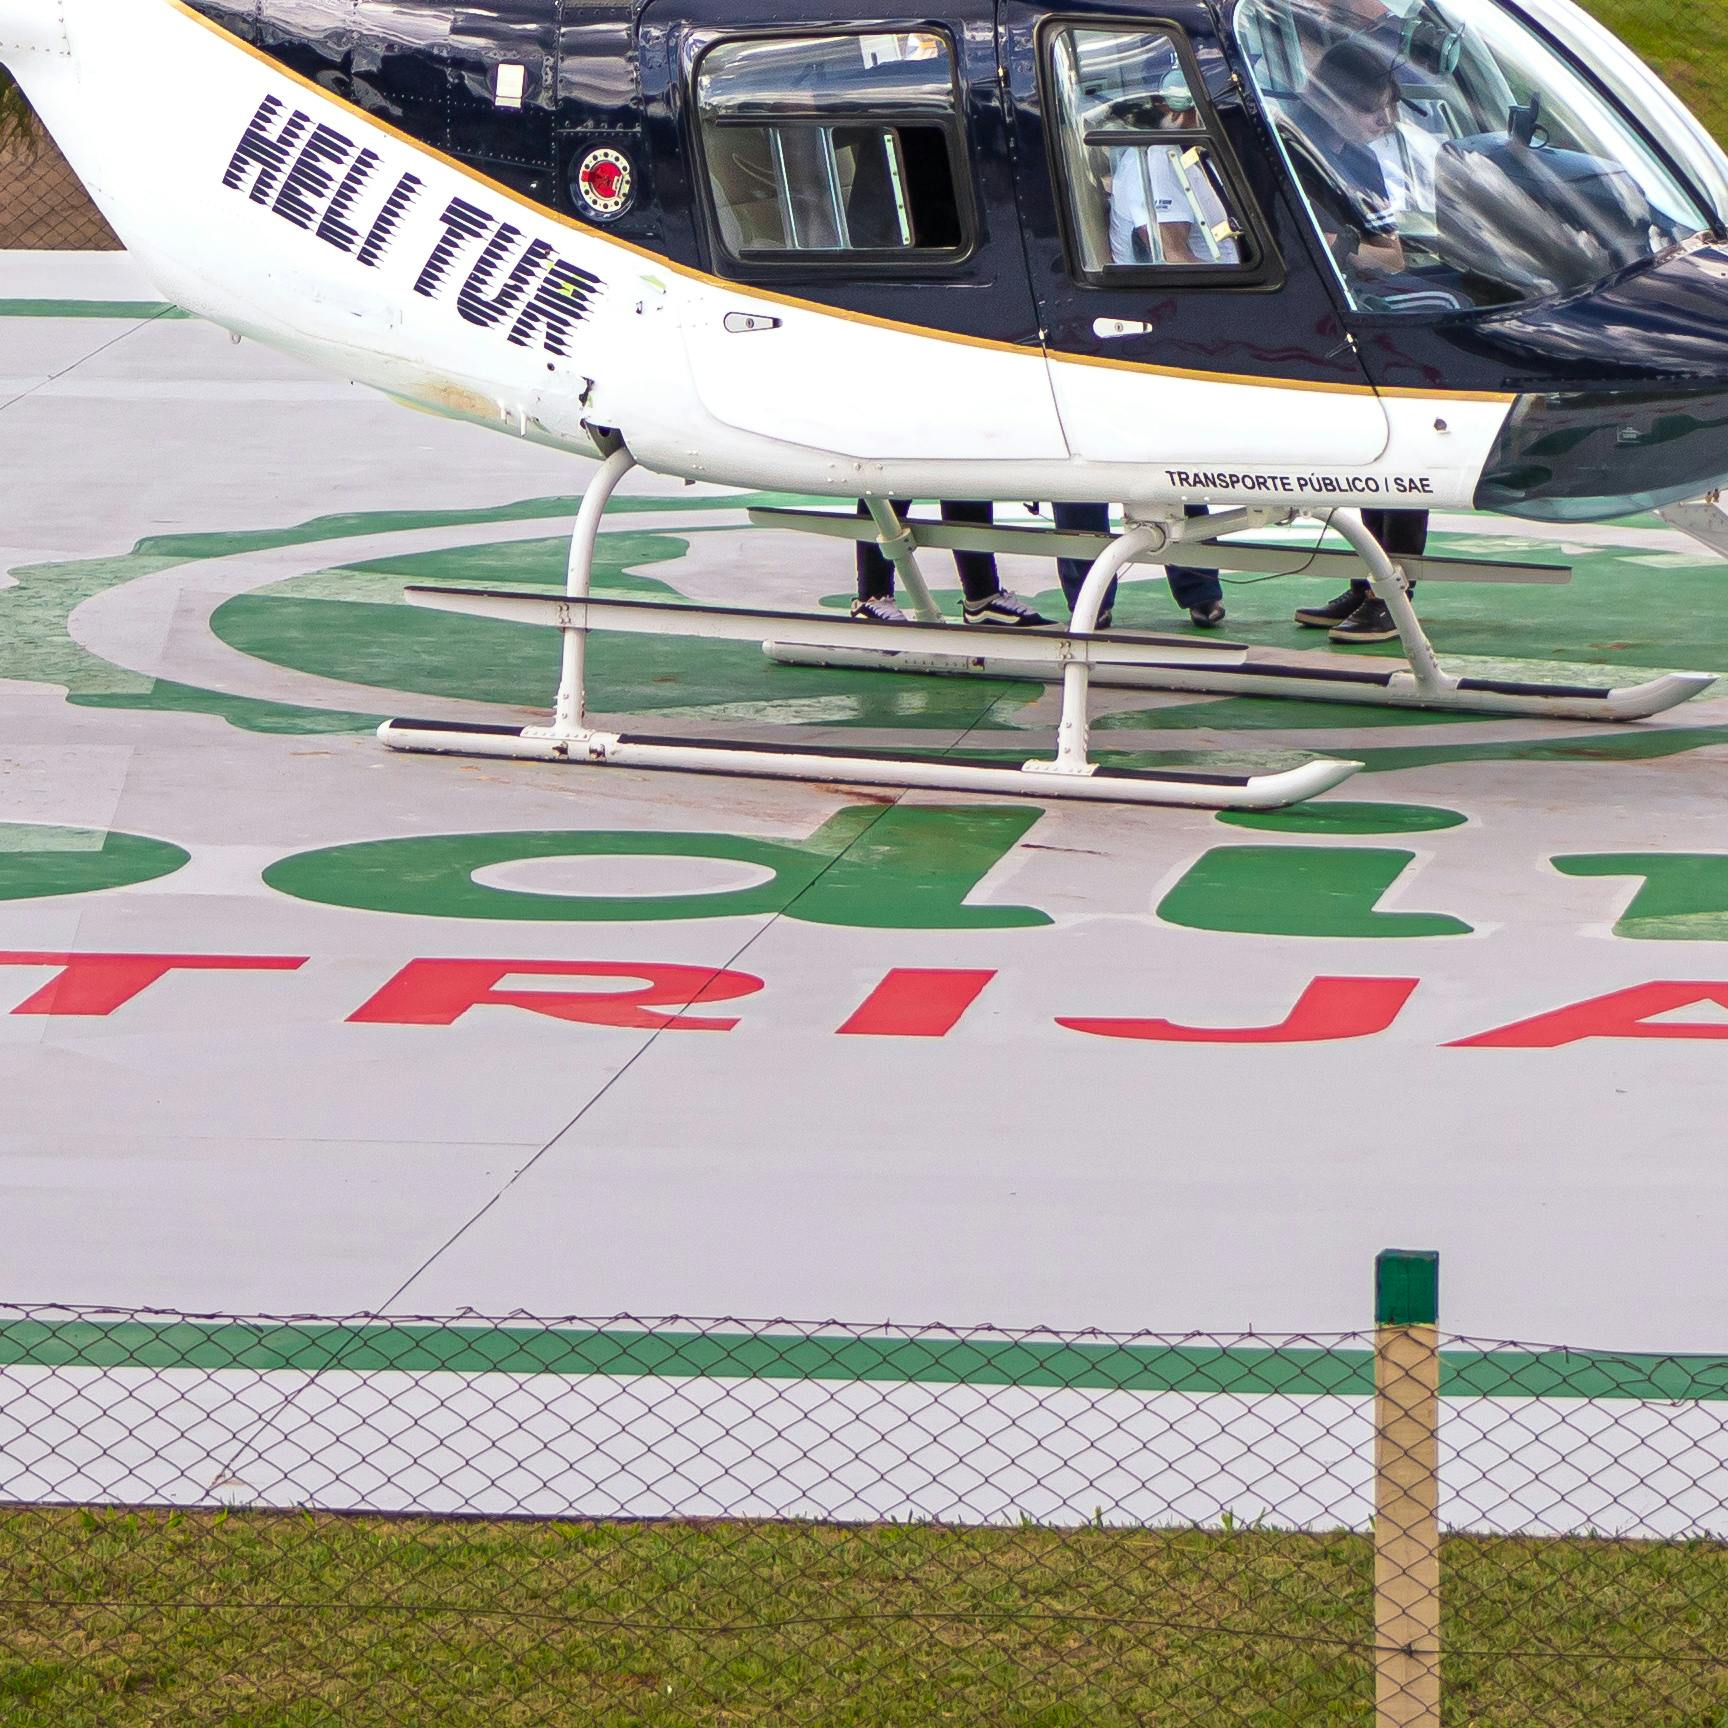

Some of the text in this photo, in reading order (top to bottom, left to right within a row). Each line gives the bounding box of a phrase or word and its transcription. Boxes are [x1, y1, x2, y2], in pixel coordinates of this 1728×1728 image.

[221, 93, 609, 358] HELI TUR
[1165, 470, 1293, 492] TRANSPORTE
[1297, 472, 1380, 494] PÚBLICO
[1393, 476, 1434, 494] SAE
